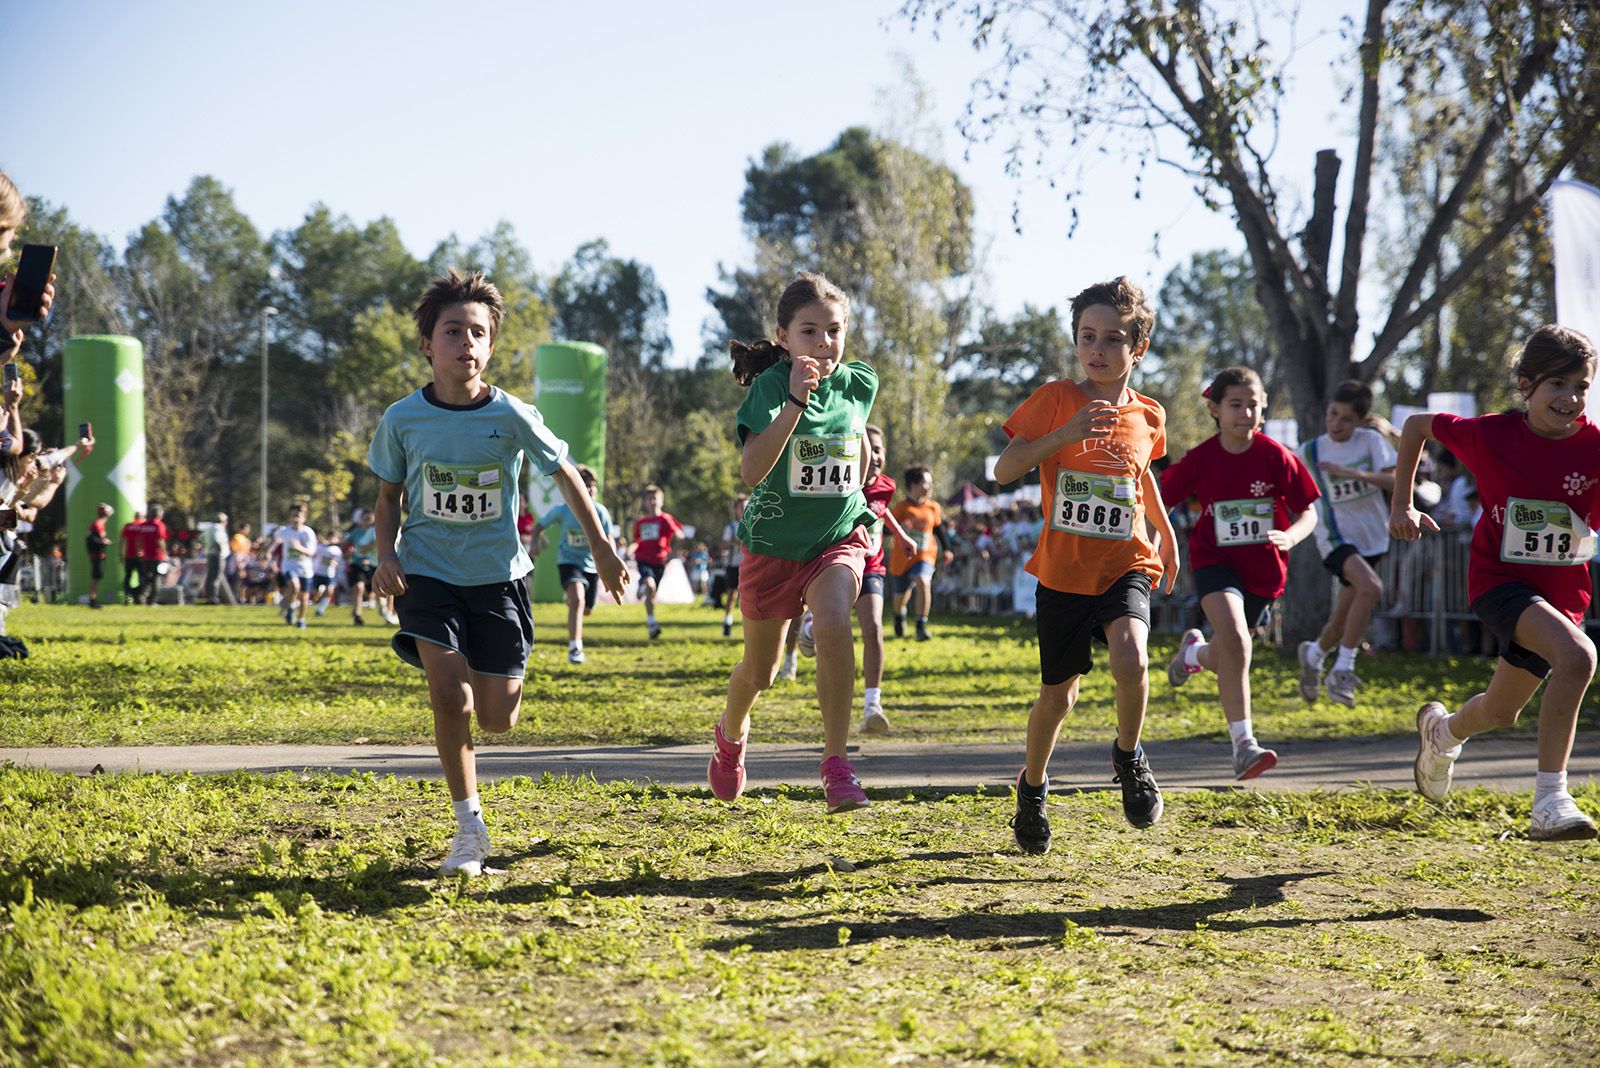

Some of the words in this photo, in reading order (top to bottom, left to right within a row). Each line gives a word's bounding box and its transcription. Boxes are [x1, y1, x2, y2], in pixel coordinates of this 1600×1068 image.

[800, 443, 825, 458] CROS
[429, 471, 454, 483] CROS
[801, 465, 851, 486] 3144
[1065, 481, 1089, 493] CROS
[433, 492, 487, 514] 1431
[1062, 500, 1122, 527] 3668
[1515, 509, 1544, 523] CROS
[1230, 521, 1259, 536] 510
[1525, 532, 1572, 553] 513
